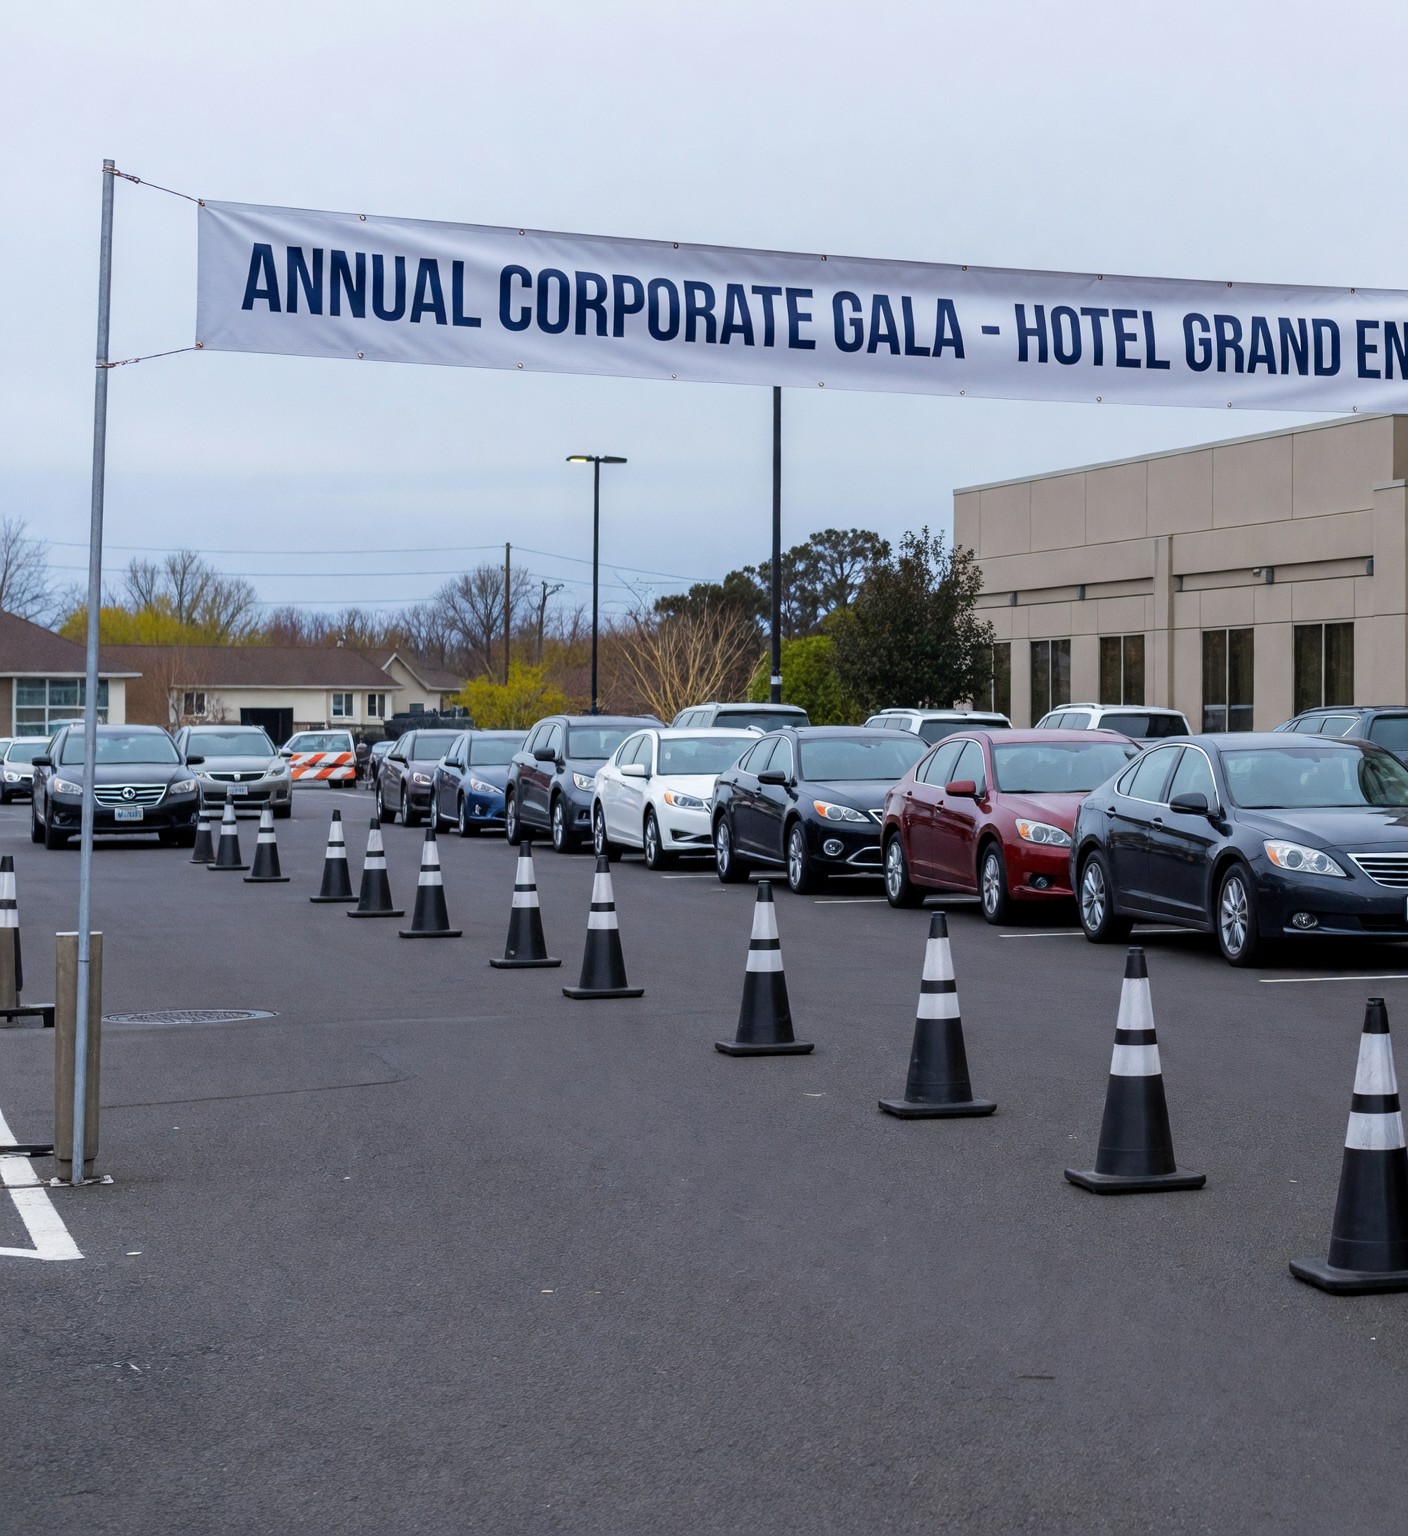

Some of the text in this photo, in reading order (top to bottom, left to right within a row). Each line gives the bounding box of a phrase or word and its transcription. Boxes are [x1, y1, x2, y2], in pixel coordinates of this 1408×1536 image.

[241, 242, 482, 328] ANNUAL
[498, 264, 816, 350] CORPORATE
[832, 290, 966, 359] GALA
[1014, 303, 1171, 370] HOTEL
[1182, 312, 1341, 377] GRAND
